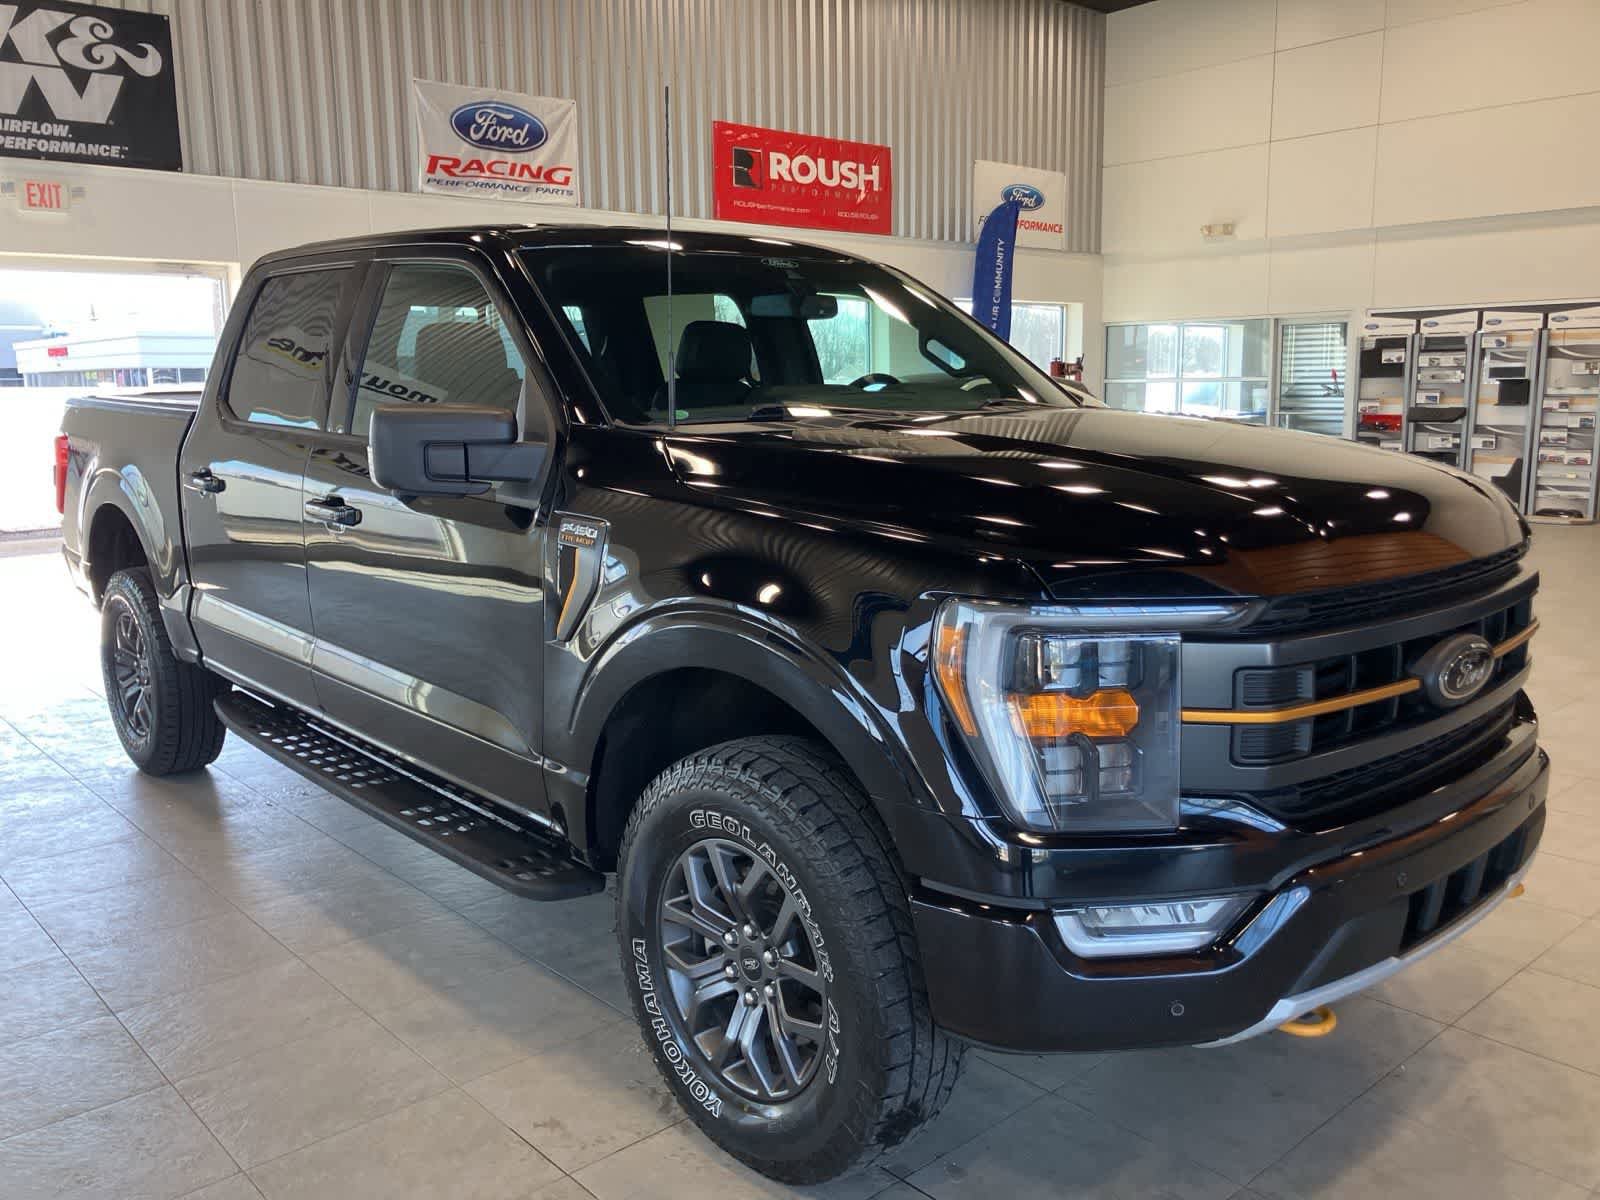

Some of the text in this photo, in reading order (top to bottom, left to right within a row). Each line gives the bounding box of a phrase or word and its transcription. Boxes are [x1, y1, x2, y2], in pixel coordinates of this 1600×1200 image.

[470, 109, 529, 145] Ford
[426, 155, 573, 186] RACING
[427, 177, 574, 196] PERFORMANCE PARTS
[769, 151, 880, 193] ROUSH
[26, 182, 62, 209] EXIT
[1016, 219, 1064, 234] FORMANCE
[689, 810, 841, 1085] GEOLANDAR A/T
[632, 937, 723, 1118] YOKOHAMA
